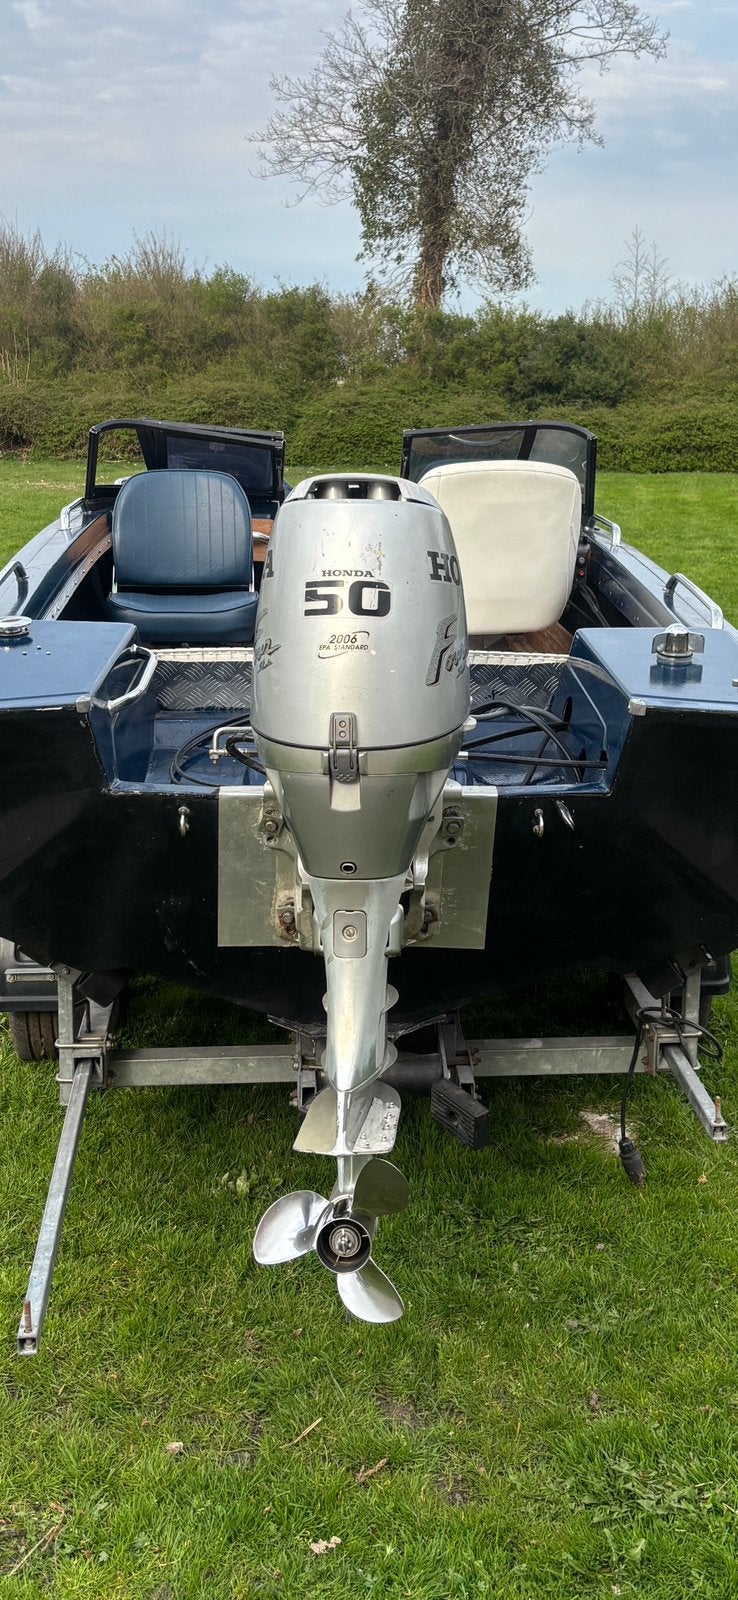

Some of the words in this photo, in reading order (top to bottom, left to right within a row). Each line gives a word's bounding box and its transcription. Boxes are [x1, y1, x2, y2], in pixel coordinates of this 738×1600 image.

[321, 569, 374, 578] HONDA
[304, 580, 391, 617] 50
[329, 634, 358, 644] 2006
